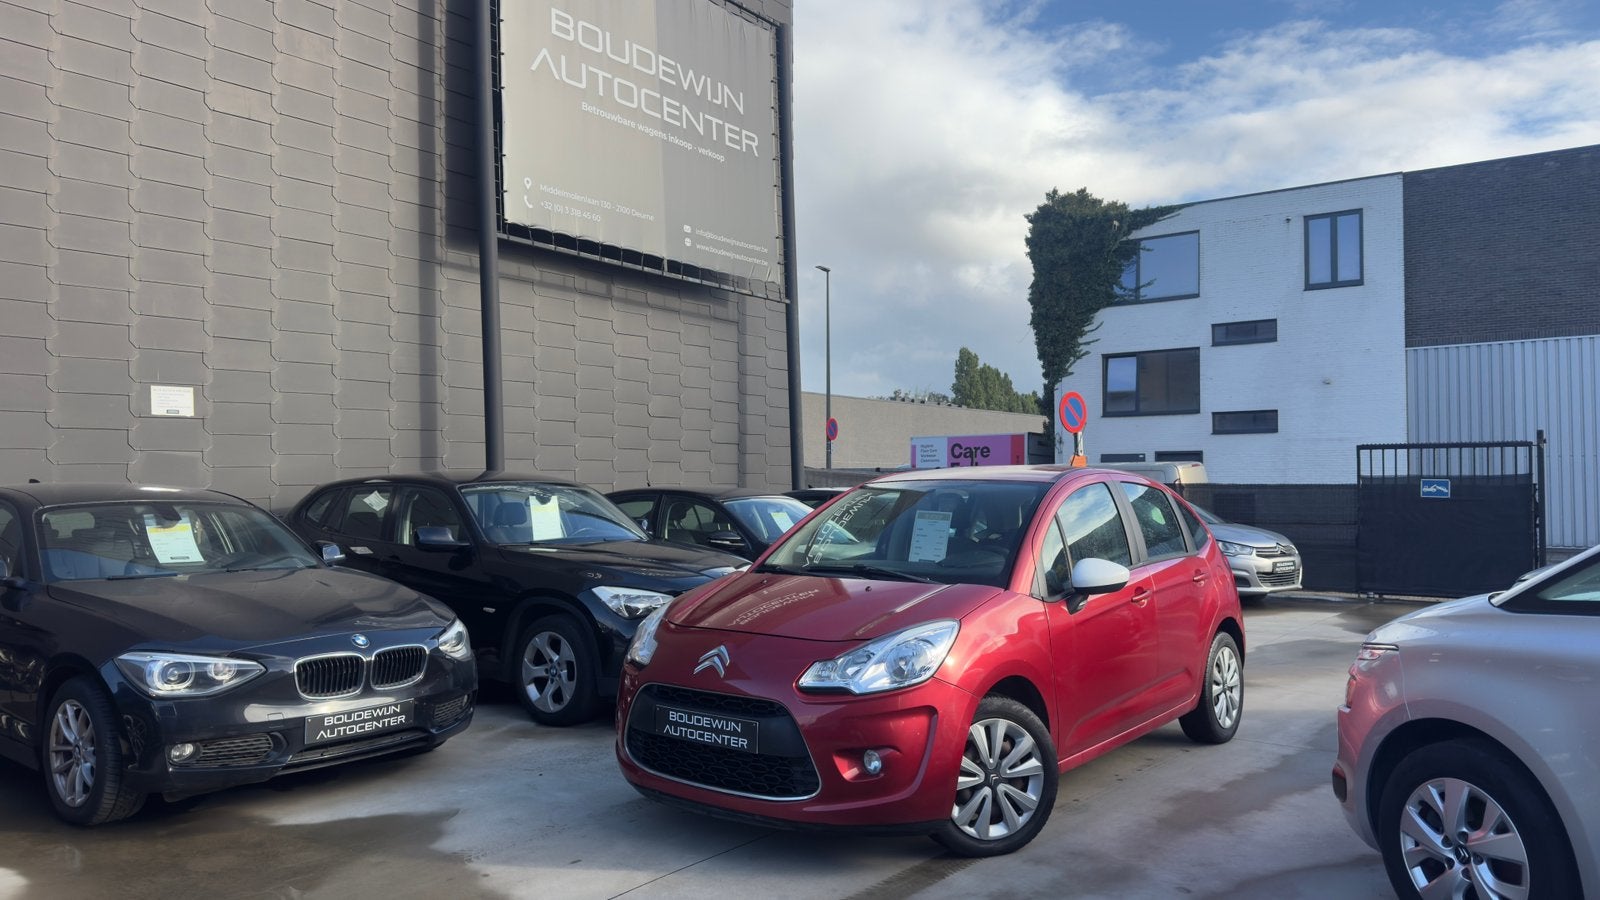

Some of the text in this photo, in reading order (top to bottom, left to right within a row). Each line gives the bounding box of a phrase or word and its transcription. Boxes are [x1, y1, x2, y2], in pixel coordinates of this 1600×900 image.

[551, 7, 744, 115] BOUDEWIJN
[530, 47, 759, 157] AUTOCENTER
[581, 101, 636, 129] Betrouwbare
[637, 122, 668, 141] wagens
[668, 133, 692, 151] inkoop
[697, 146, 725, 163] verkoop
[631, 208, 655, 221] Deurne
[951, 442, 991, 459] Care
[316, 715, 406, 740] AUTOCENTER
[324, 704, 400, 726] BOUDEWIJN
[669, 711, 741, 733] BOUDEWIJN
[663, 724, 748, 749] AUTOCENTER
